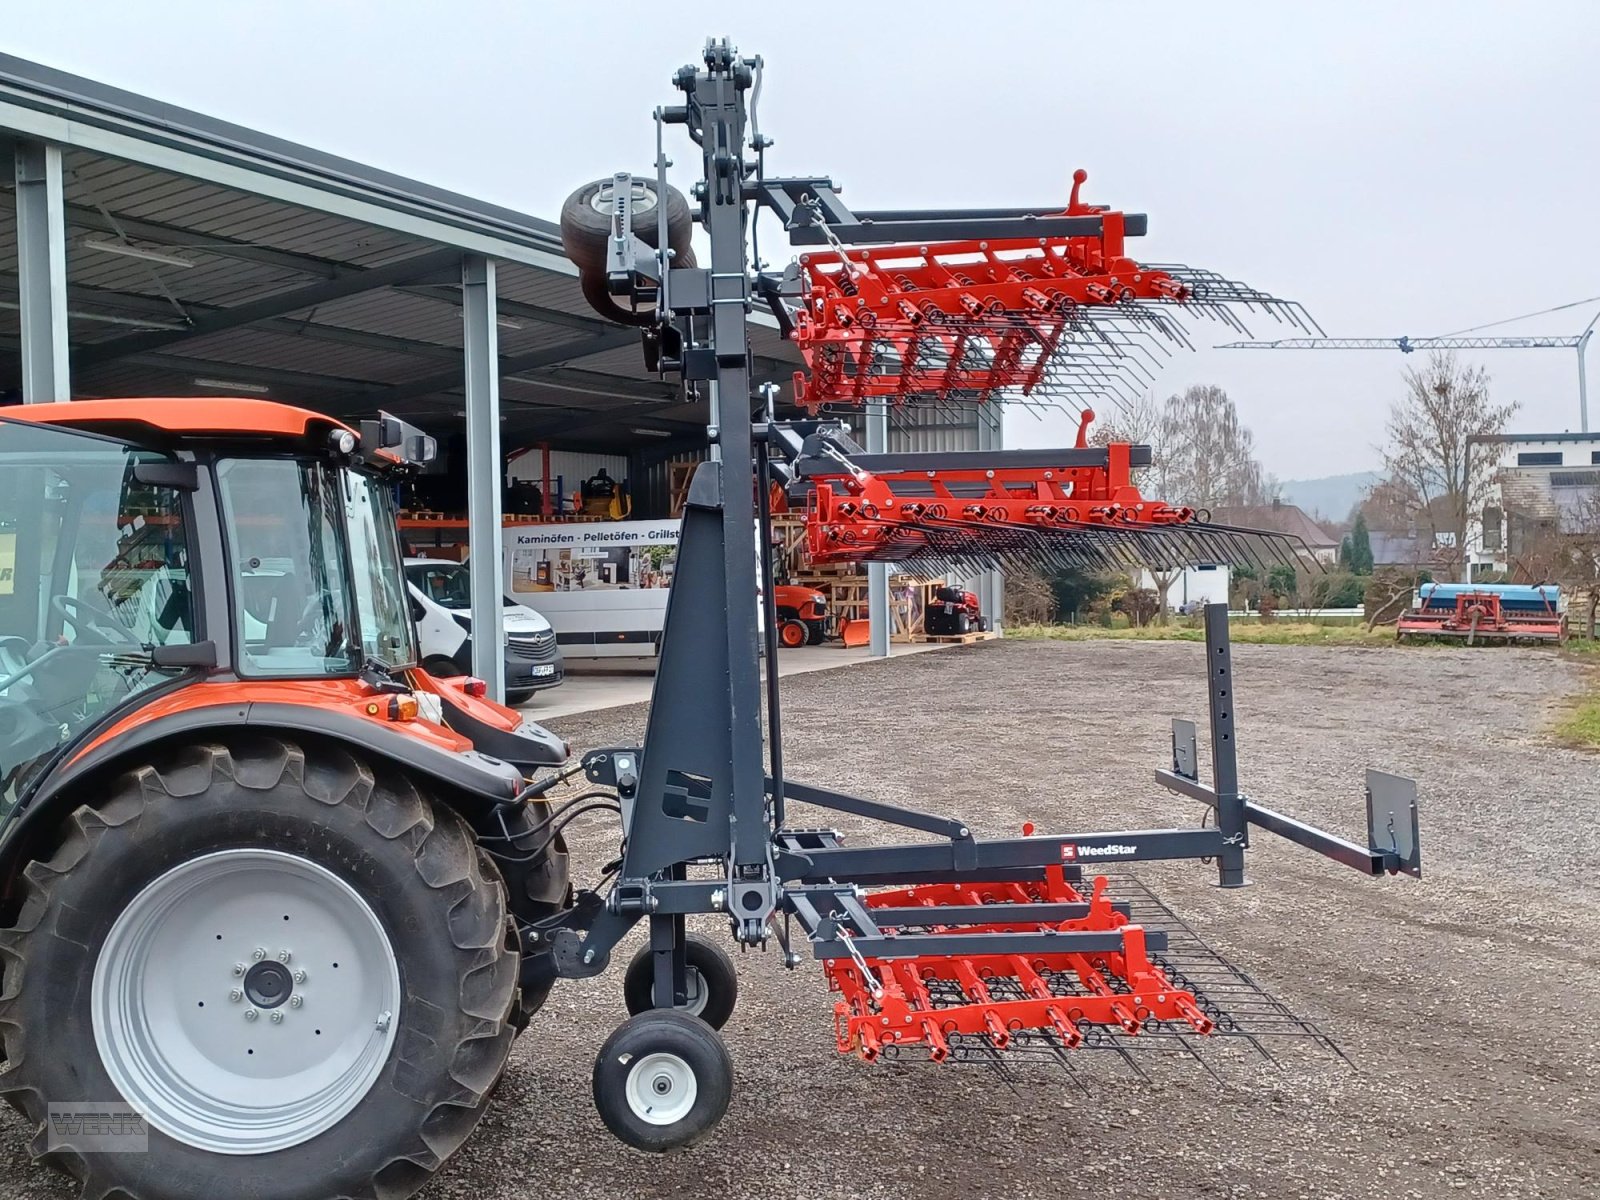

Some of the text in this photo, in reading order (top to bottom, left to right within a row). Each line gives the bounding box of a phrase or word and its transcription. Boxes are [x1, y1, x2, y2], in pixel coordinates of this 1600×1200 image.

[517, 533, 574, 544] Kaminöfen
[583, 531, 638, 542] Pelletöfen
[1077, 844, 1137, 857] WeedStar
